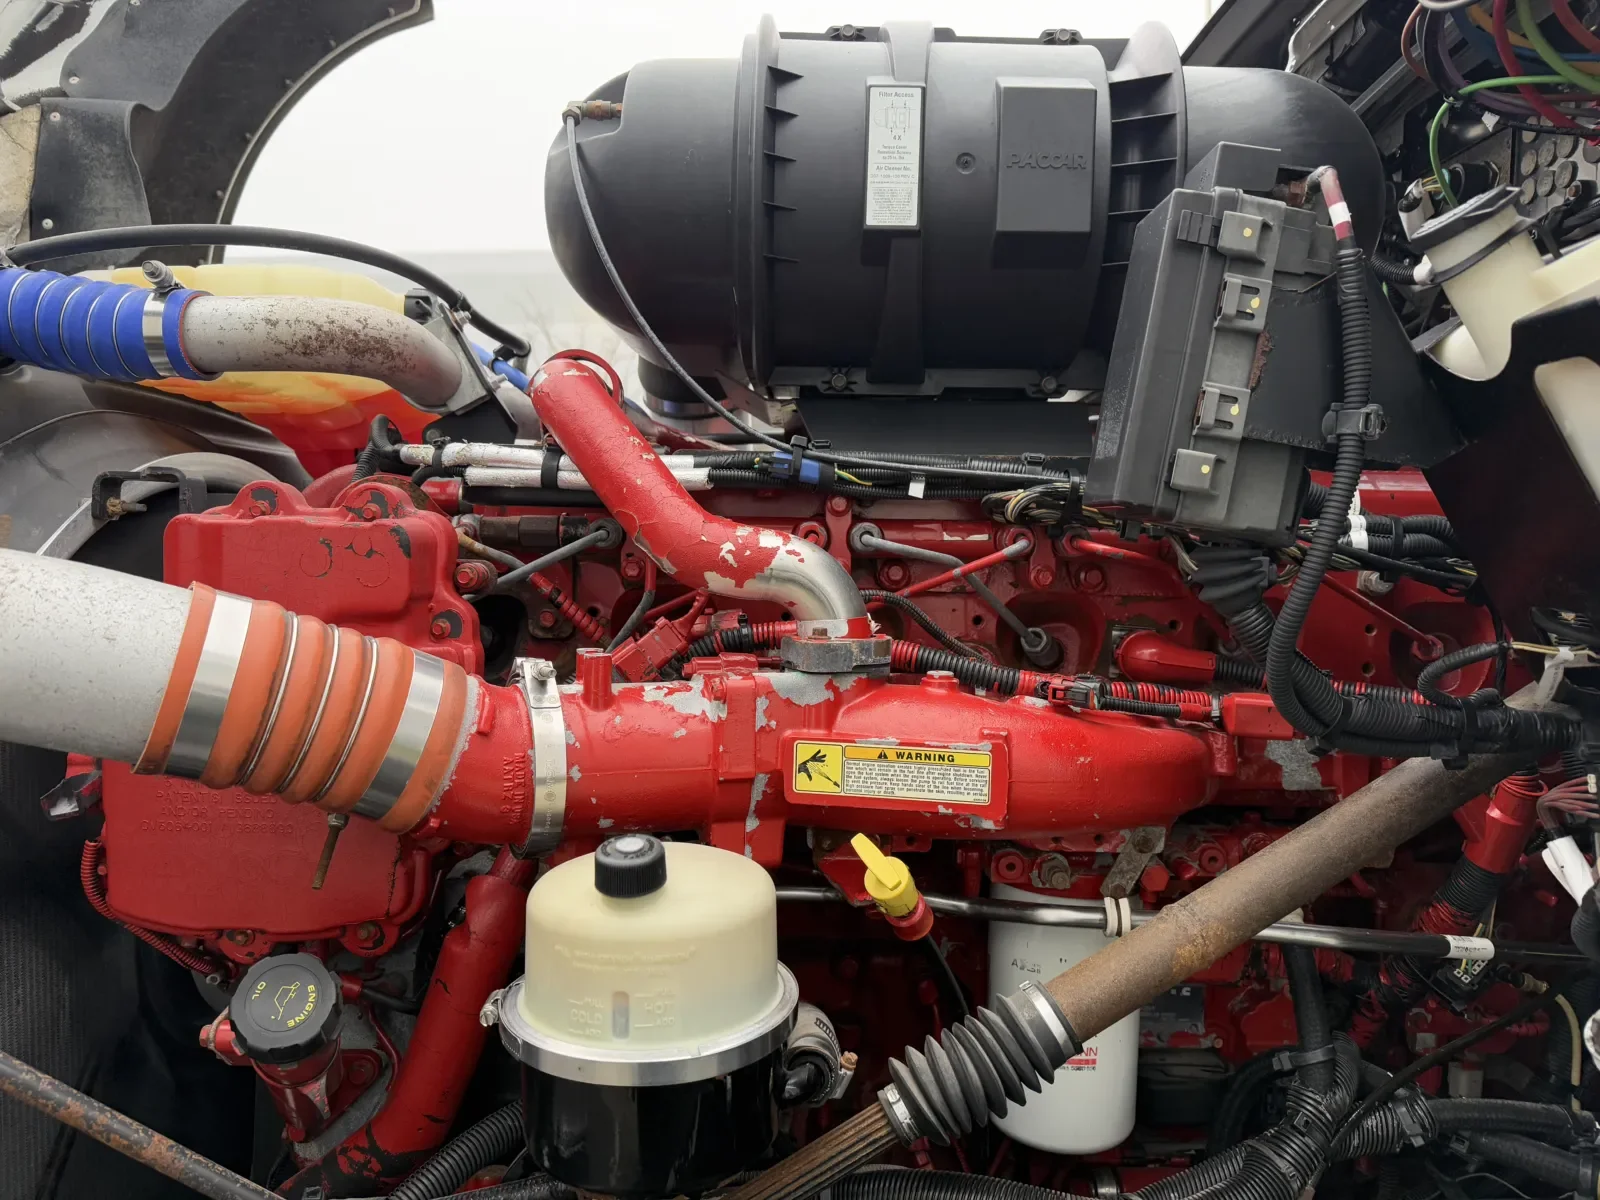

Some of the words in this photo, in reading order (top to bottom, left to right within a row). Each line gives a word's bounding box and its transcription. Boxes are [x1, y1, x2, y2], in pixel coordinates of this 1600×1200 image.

[1006, 152, 1087, 170] PACCAR
[896, 751, 955, 762] WARNING
[514, 752, 525, 787] MADE
[234, 792, 278, 804] ISSUED
[513, 791, 525, 803] IN
[161, 807, 209, 818] AND/OR
[219, 808, 275, 819] PENDING
[509, 805, 522, 824] USA
[251, 981, 267, 1000] OIL
[286, 984, 316, 1028] ENGINE
[584, 996, 604, 1008] FULL
[644, 1001, 674, 1014] HOT
[570, 1009, 603, 1025] COLD
[655, 1016, 675, 1026] ADD
[585, 1027, 602, 1037] ADD
